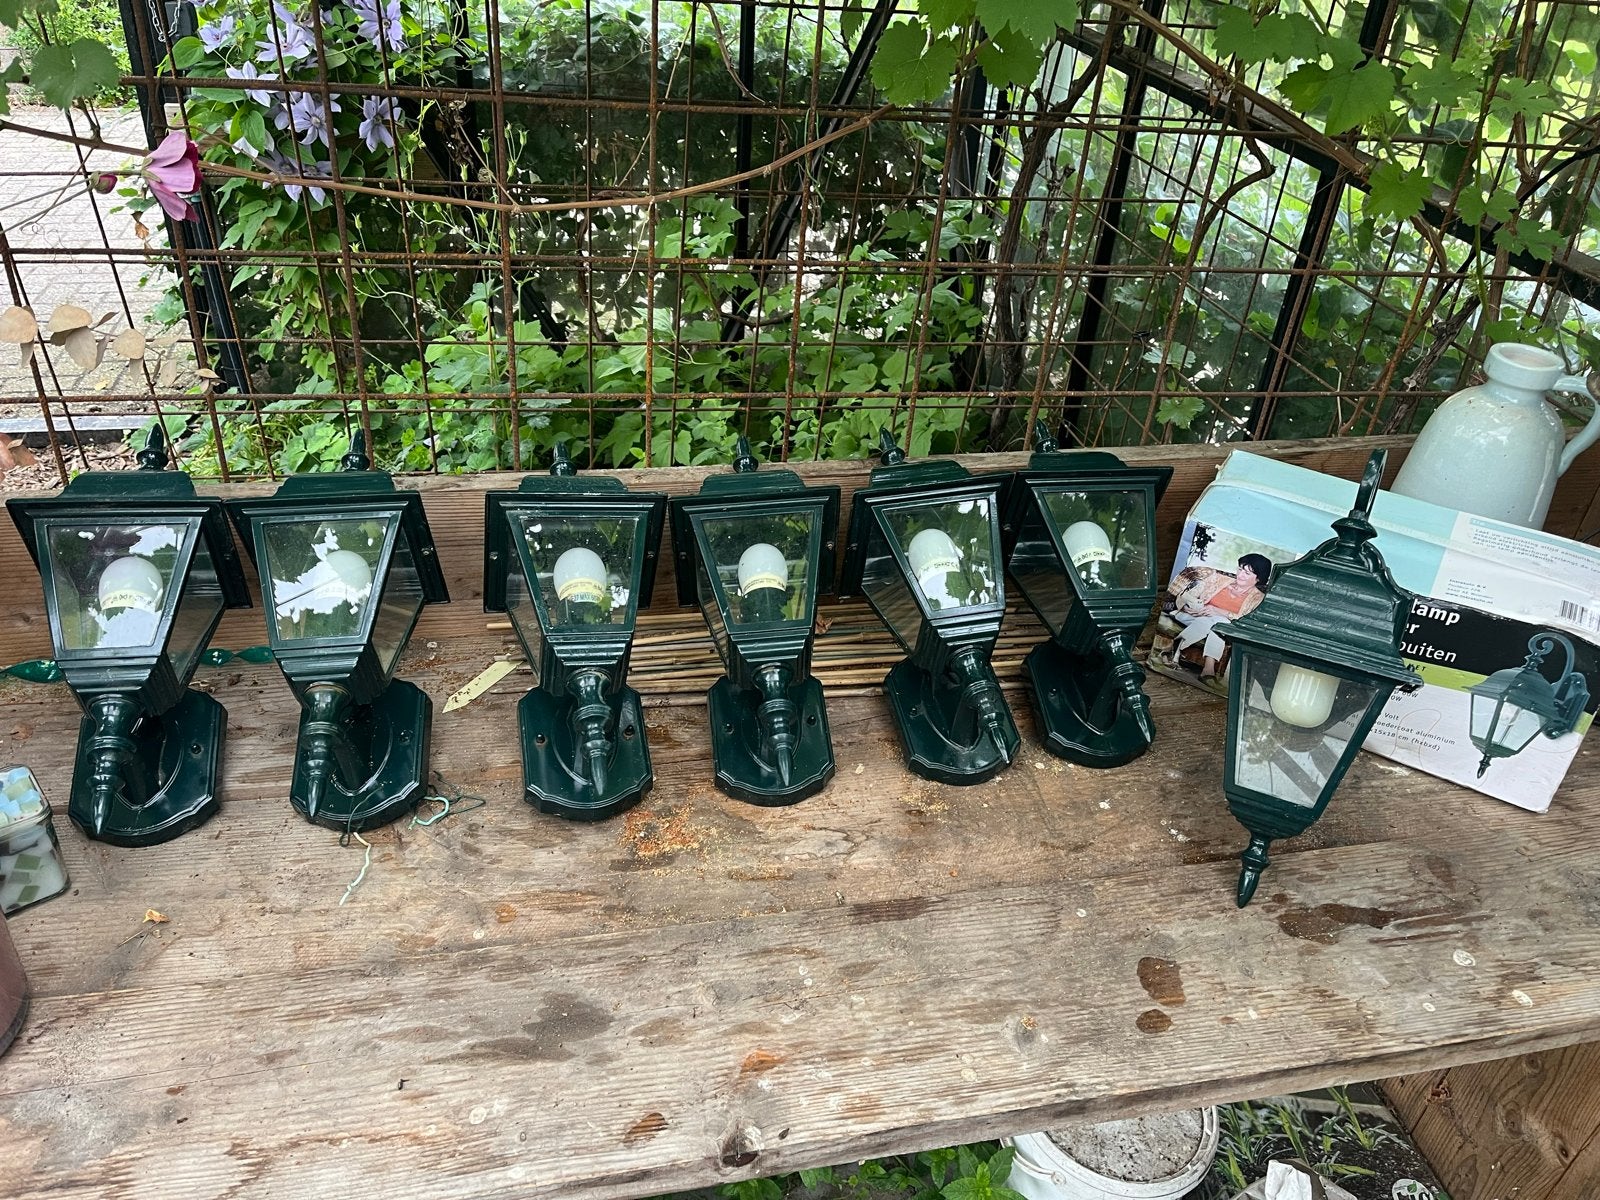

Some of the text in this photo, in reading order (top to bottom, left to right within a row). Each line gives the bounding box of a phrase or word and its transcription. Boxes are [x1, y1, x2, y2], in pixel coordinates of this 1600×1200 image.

[1411, 598, 1460, 626] lamp
[1384, 712, 1400, 721] Volt
[1375, 720, 1456, 745] oedercoat aluminium
